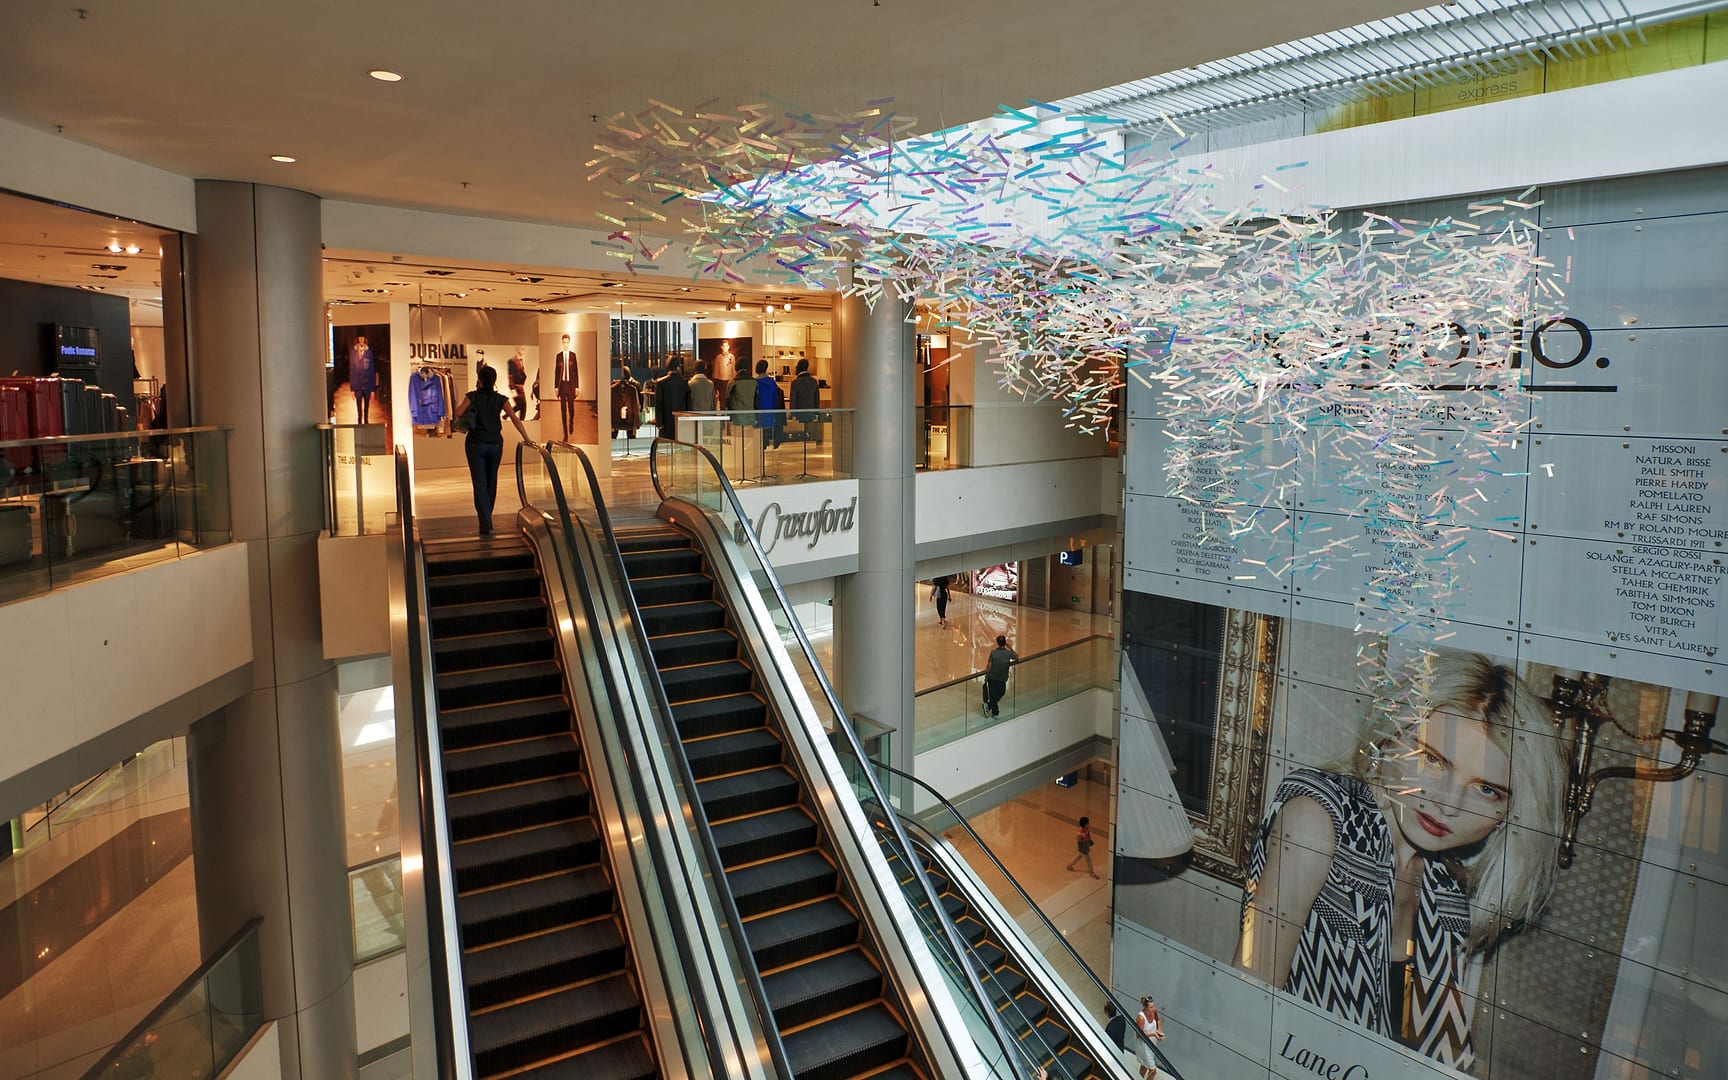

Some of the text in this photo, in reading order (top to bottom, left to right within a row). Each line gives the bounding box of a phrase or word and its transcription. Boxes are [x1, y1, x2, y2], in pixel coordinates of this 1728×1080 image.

[1458, 81, 1518, 101] express
[1652, 445, 1696, 454] MISSONI
[1635, 455, 1682, 466] NATURA
[1641, 467, 1704, 478] PAUL SMITH
[1635, 478, 1709, 490] PIERRE HARDY
[1639, 490, 1704, 501] POMELLATO
[1630, 500, 1711, 514] RALPH LAUREN
[755, 497, 857, 554] Crawford
[1636, 512, 1703, 525] RAF SIMONS
[1604, 520, 1620, 529] RM
[1624, 522, 1635, 530] BY
[1639, 524, 1685, 535] ROLAND
[1631, 534, 1705, 549] TRUSSARDI 1911
[1060, 551, 1068, 564] P
[1586, 551, 1634, 564] SOLANGE
[1632, 545, 1702, 560] SERGIO ROSSI
[1612, 566, 1721, 585] STELLA MCCARTNEY
[1620, 577, 1709, 596] TAHER CHEMIRIK
[1615, 588, 1715, 608] TABITHA SIMMONS
[1631, 601, 1695, 617] TOM DIXON
[1629, 612, 1696, 629] TORY BURCH
[1645, 625, 1678, 638] VITRA
[1605, 630, 1720, 655] YVES SAINT LAURENT
[1278, 1032, 1341, 1080] Lane
